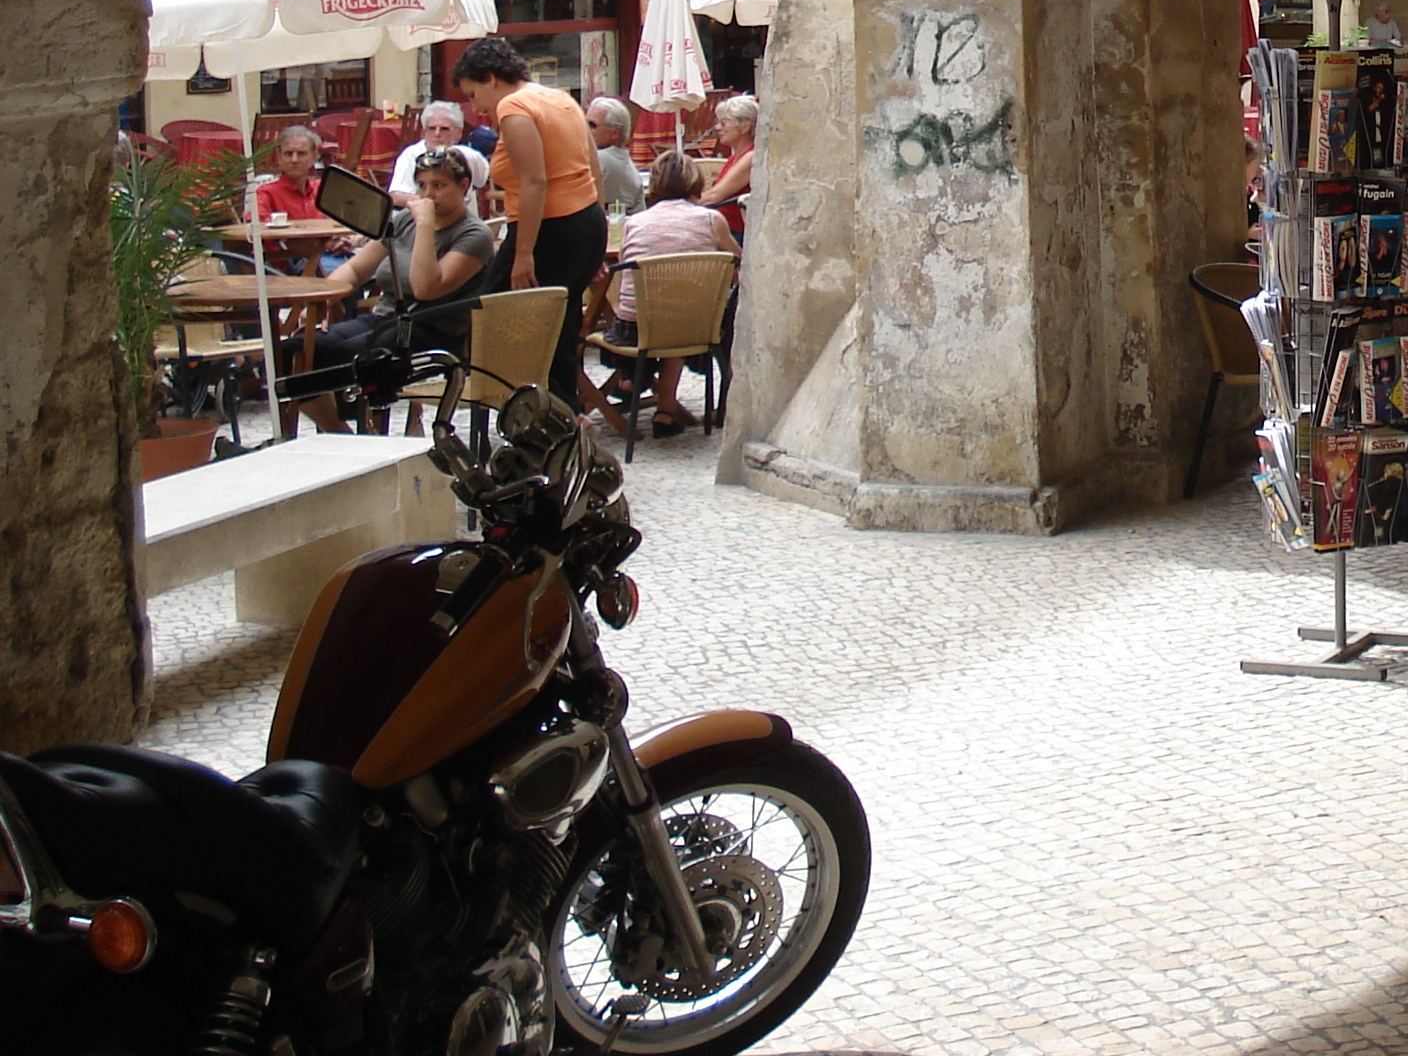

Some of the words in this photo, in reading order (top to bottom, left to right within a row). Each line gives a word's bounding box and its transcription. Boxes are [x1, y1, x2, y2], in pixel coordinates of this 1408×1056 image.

[1358, 55, 1392, 66] Collins
[1363, 188, 1395, 201] fugain
[1371, 439, 1406, 451] Sanson
